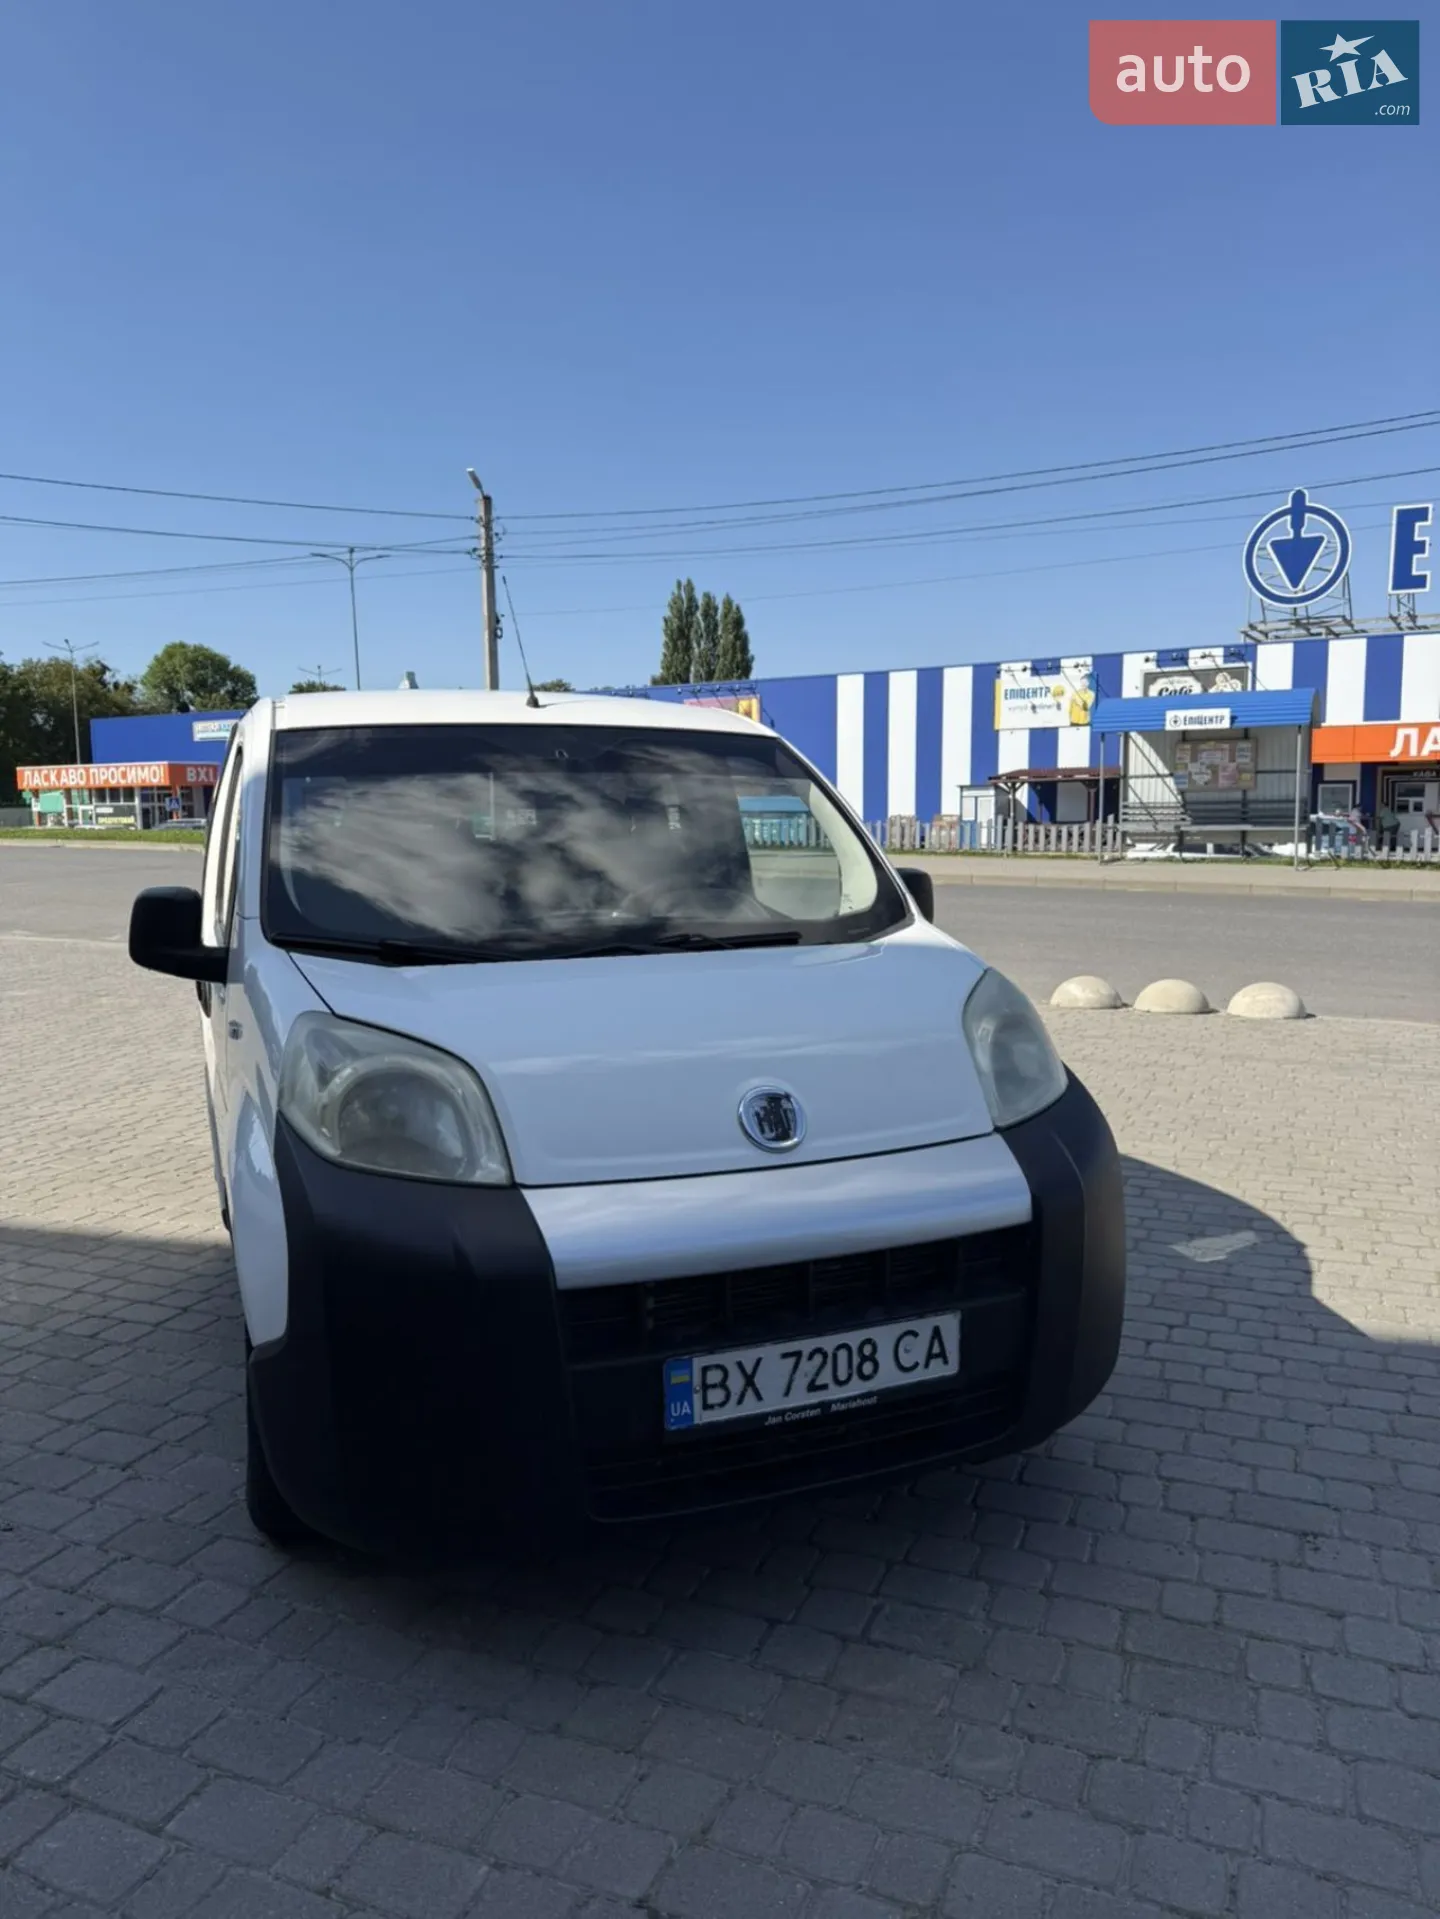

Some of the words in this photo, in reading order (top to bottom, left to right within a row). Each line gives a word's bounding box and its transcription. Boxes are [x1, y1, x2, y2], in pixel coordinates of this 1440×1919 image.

[1388, 503, 1433, 594] Е
[1004, 686, 1051, 700] ЕПІЦЕНТР
[1183, 714, 1225, 726] ЕПІЦЕНТР
[23, 768, 86, 787] ЛАСКАВО
[89, 765, 165, 785] ПРОСИМО!
[701, 1356, 765, 1412] BX
[780, 1337, 880, 1397] 7208
[894, 1325, 950, 1374] CA
[670, 1400, 692, 1417] UA
[764, 1414, 783, 1426] Jan
[784, 1407, 822, 1422] Corsten
